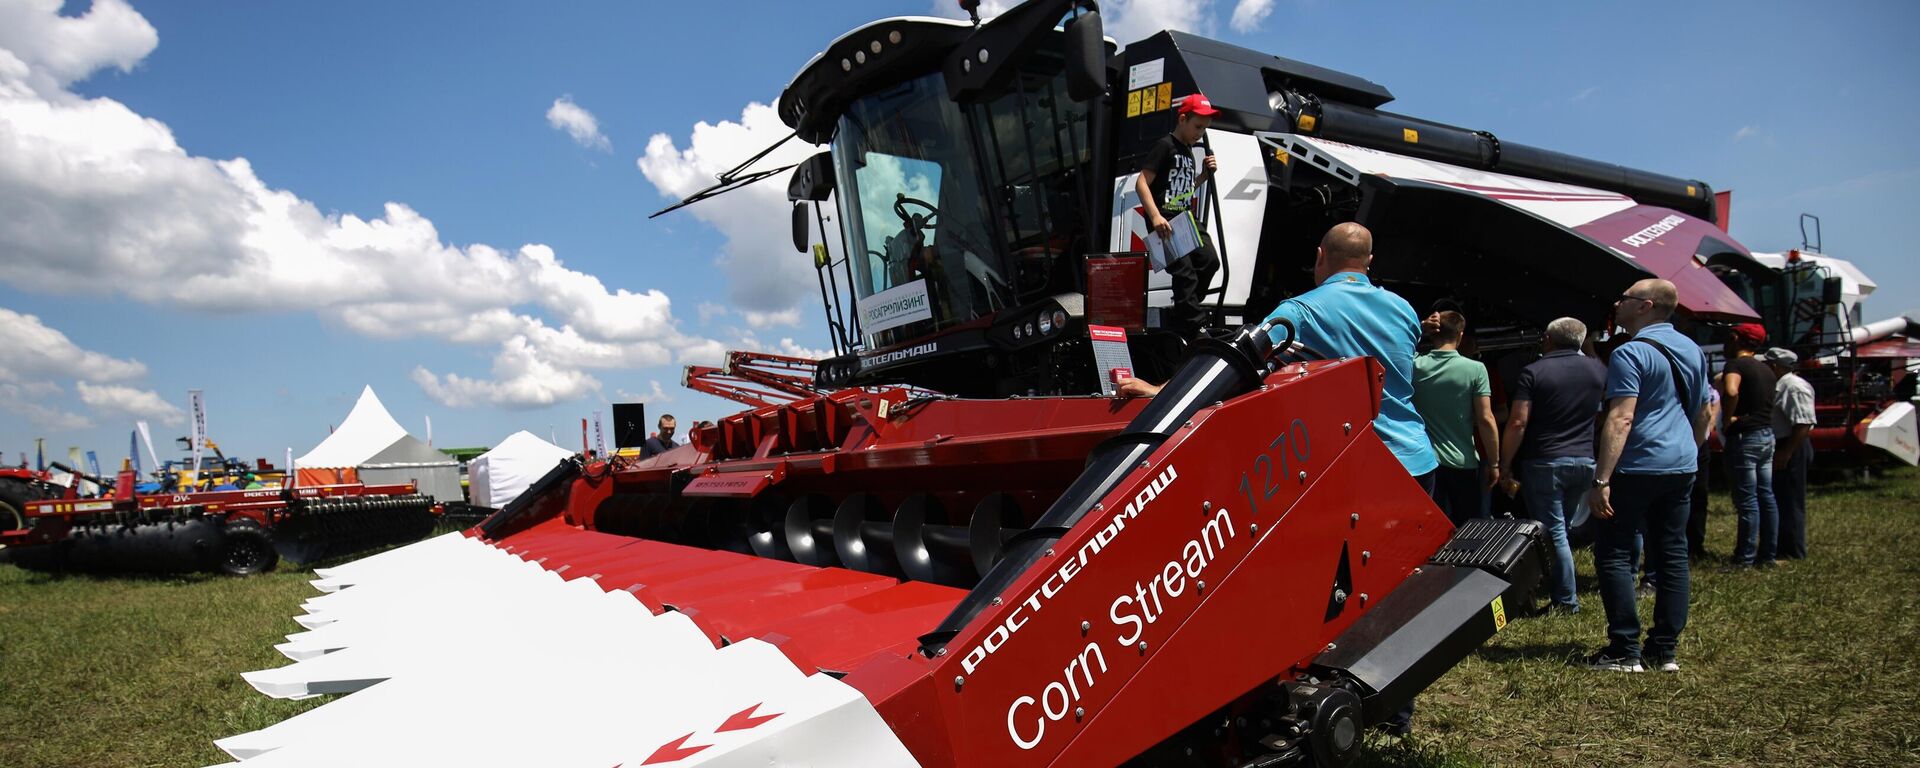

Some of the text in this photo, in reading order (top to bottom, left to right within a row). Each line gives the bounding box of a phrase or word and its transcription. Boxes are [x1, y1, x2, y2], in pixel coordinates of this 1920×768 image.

[1174, 154, 1193, 168] THE
[961, 463, 1178, 676] РОСТСЕЛЬМАШ
[1006, 417, 1312, 750] Corn Stream 1270
